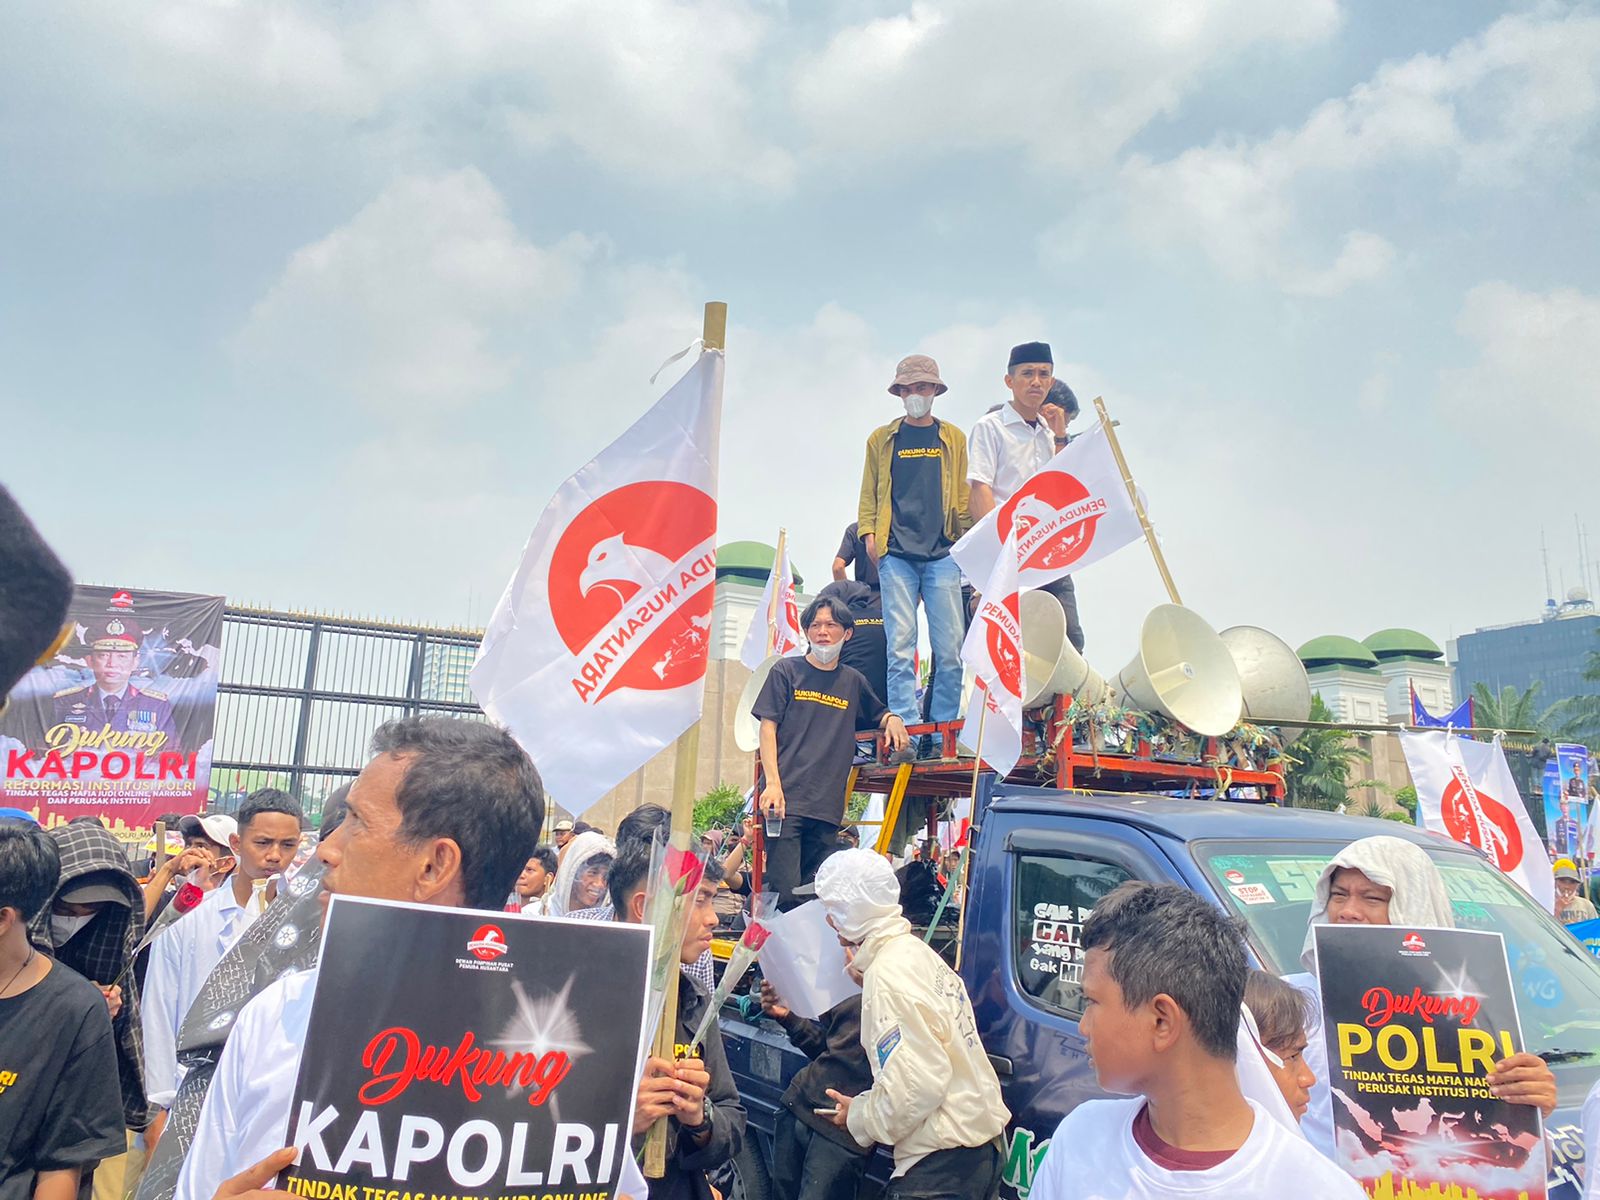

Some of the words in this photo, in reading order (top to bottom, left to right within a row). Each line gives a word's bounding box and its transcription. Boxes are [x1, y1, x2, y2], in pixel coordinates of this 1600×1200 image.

[795, 689, 821, 699] DUKUNG
[822, 693, 849, 706] KAPOLRI
[45, 723, 167, 757] Dukung
[6, 750, 196, 780] KAPOLRI
[4, 780, 84, 790] REFORMASI
[88, 781, 154, 791] INSTITUSI
[157, 781, 196, 791] POLRI
[6, 789, 39, 797] TINDAK
[117, 790, 151, 798] ONLINE,
[1453, 765, 1480, 811] PEMUDA
[47, 797, 67, 805] DAN
[68, 797, 109, 805] PERUSAK
[110, 797, 151, 805] INSTITUSI
[1238, 886, 1258, 895] STOP
[1030, 957, 1058, 974] Gak
[1361, 987, 1480, 1027] Dukung
[1337, 1022, 1515, 1074] POLRI
[358, 1027, 572, 1105] Dukung
[1342, 1070, 1386, 1082] TINDAK
[1387, 1072, 1424, 1084] TEGAS
[1426, 1075, 1464, 1087] MAFIA
[1358, 1082, 1410, 1095] PERUSAK
[1413, 1086, 1469, 1098] INSTITUSI
[293, 1100, 619, 1188] KAPOLRI
[287, 1176, 359, 1200] TINDAK
